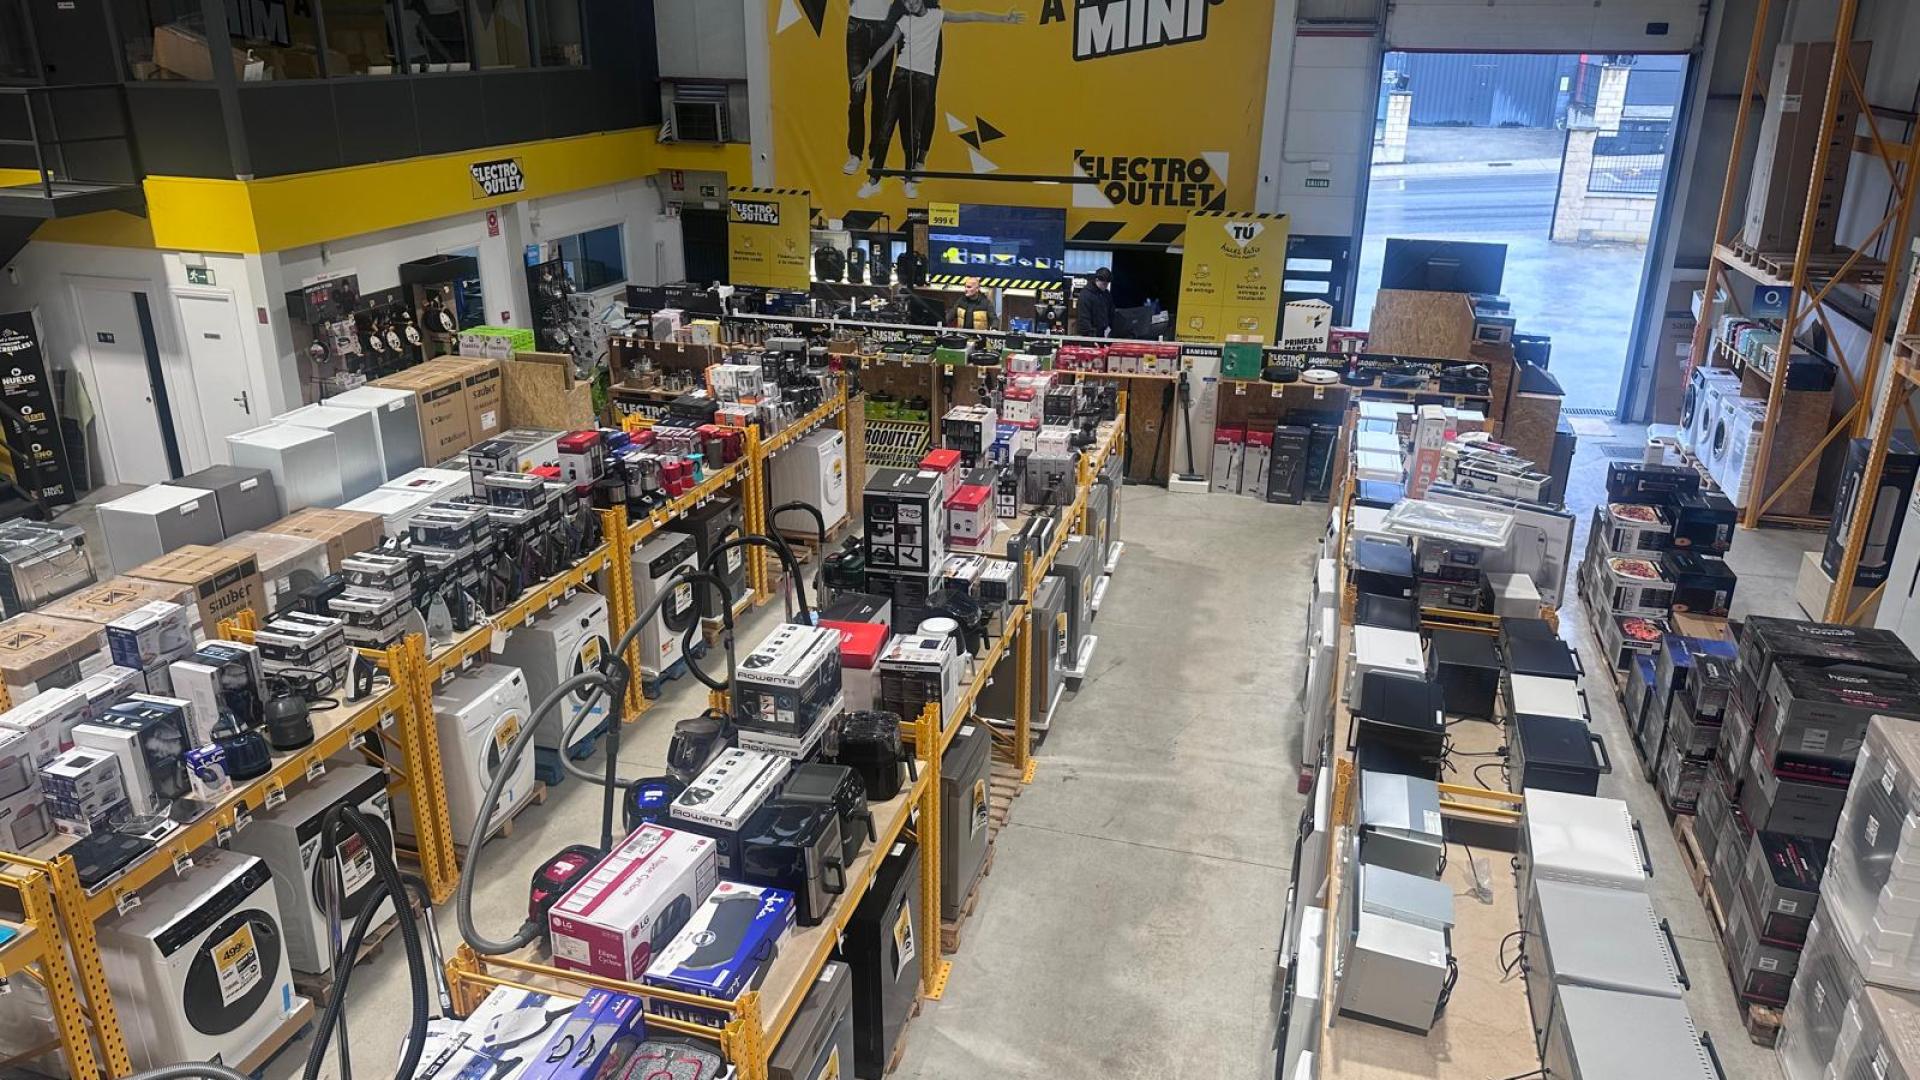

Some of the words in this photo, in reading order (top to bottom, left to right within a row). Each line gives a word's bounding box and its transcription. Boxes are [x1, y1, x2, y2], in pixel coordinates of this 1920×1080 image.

[1039, 0, 1066, 25] A
[1077, 0, 1203, 57] MINI
[472, 162, 518, 182] ELECTRO
[1079, 156, 1210, 182] ELECTRO
[484, 175, 522, 194] OUTLET
[1104, 181, 1216, 207] OUTLET
[731, 201, 772, 213] ELECTRO
[741, 212, 775, 222] OUTLET
[1233, 222, 1255, 240] TÚ
[1284, 336, 1324, 346] PRIMERAS
[1186, 348, 1218, 356] SAMSUNG
[2, 374, 36, 385] NUEVO
[614, 400, 669, 418] ELECTRO
[209, 583, 253, 615] sauber
[562, 920, 573, 930] LG
[640, 915, 650, 929] LG
